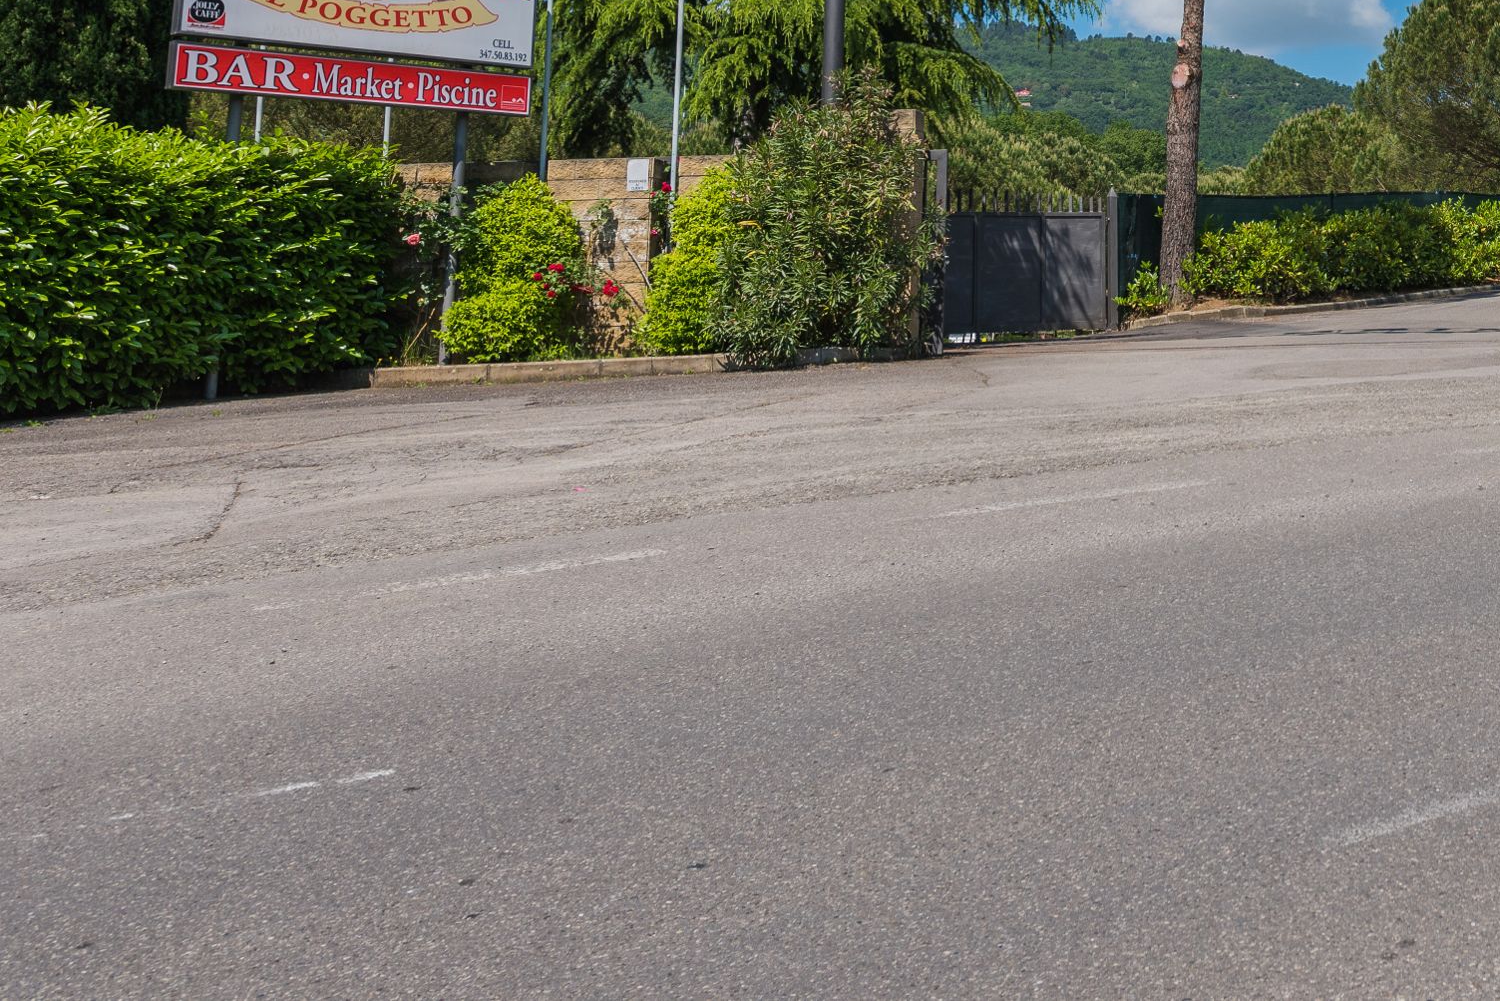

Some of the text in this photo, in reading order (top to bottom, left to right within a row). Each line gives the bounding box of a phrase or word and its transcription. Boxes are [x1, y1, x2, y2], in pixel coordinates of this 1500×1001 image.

[193, 0, 220, 10] JOLLY
[479, 48, 528, 62] 347.50.83.192
[181, 49, 497, 108] BAR Market Piscine
